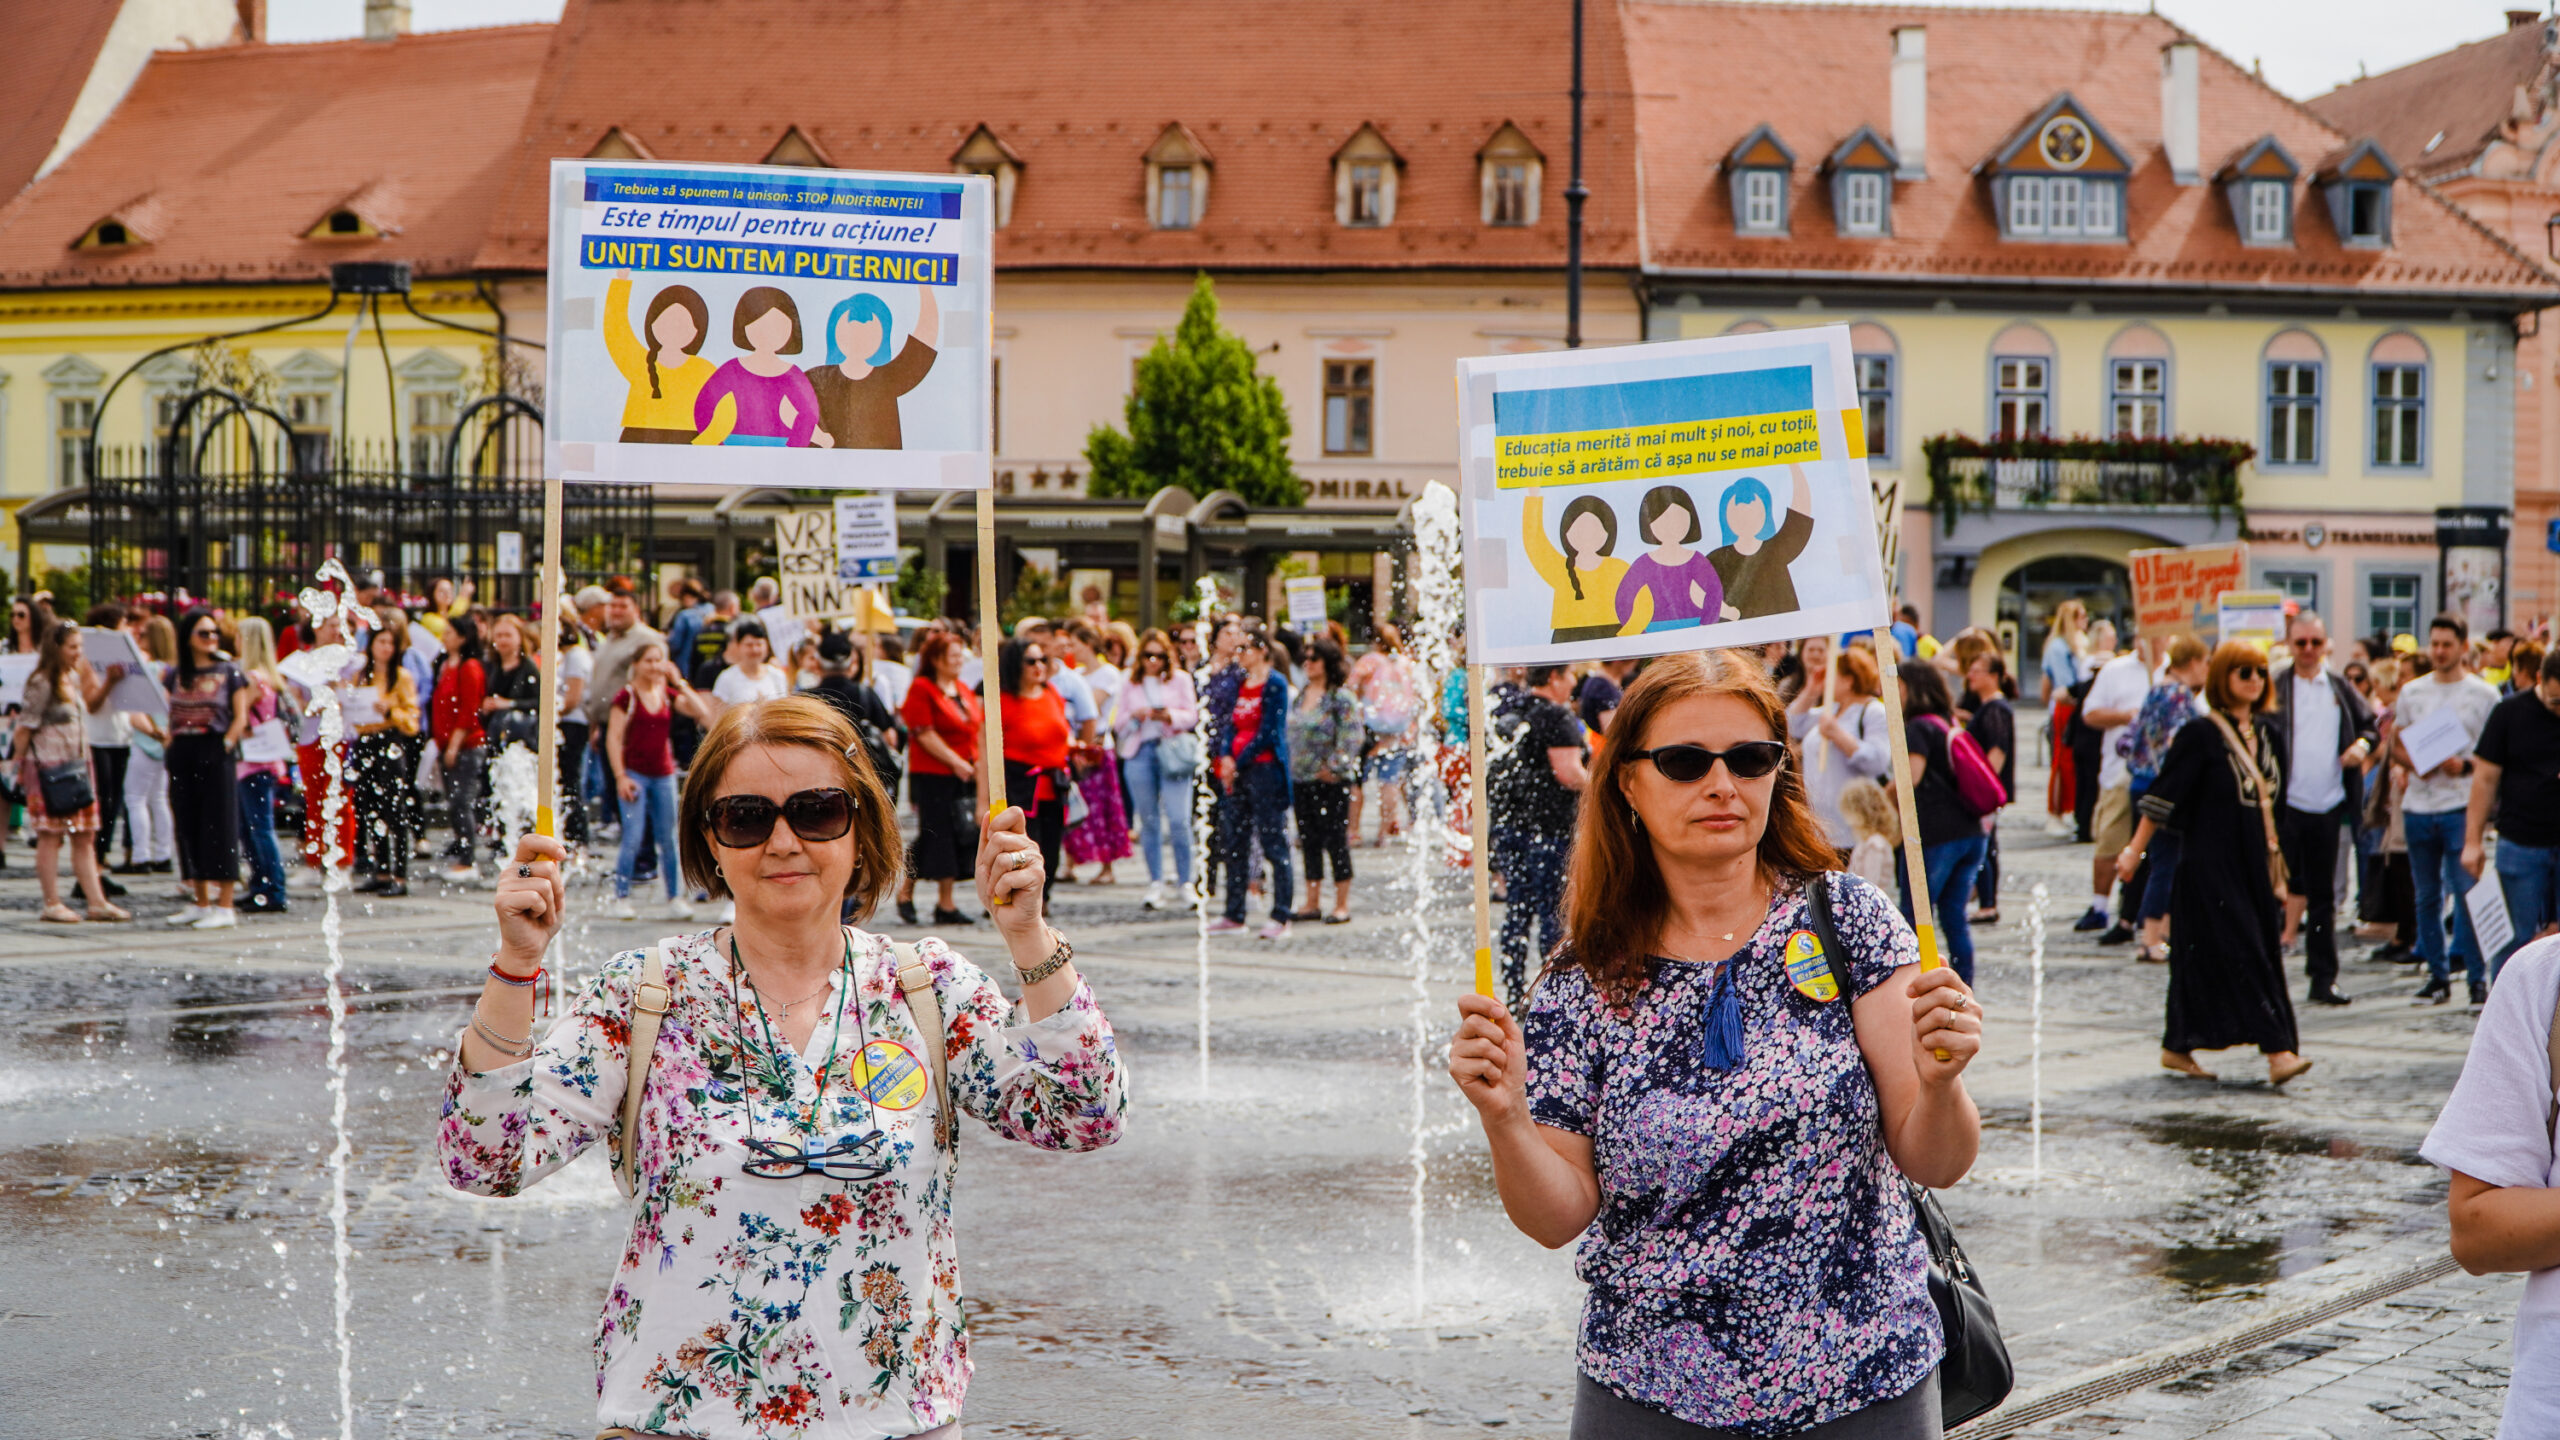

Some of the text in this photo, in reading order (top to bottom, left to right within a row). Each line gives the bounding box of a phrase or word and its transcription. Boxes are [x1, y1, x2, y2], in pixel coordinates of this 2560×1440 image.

[613, 183, 659, 196] Trebuie
[662, 185, 676, 197] să
[679, 187, 730, 199] spunem
[732, 187, 744, 199] la
[747, 190, 793, 203] unison:
[796, 191, 829, 204] STOP
[600, 207, 937, 245] Este timpul pentru acțiune!
[587, 240, 949, 283] UNIȚI SUNTEM PUTERNICI!
[1504, 415, 1817, 457] Educația merită mai mult și noi, cu toții,
[1497, 439, 1818, 479] trebuie să arătăm că așa nu se mai poate
